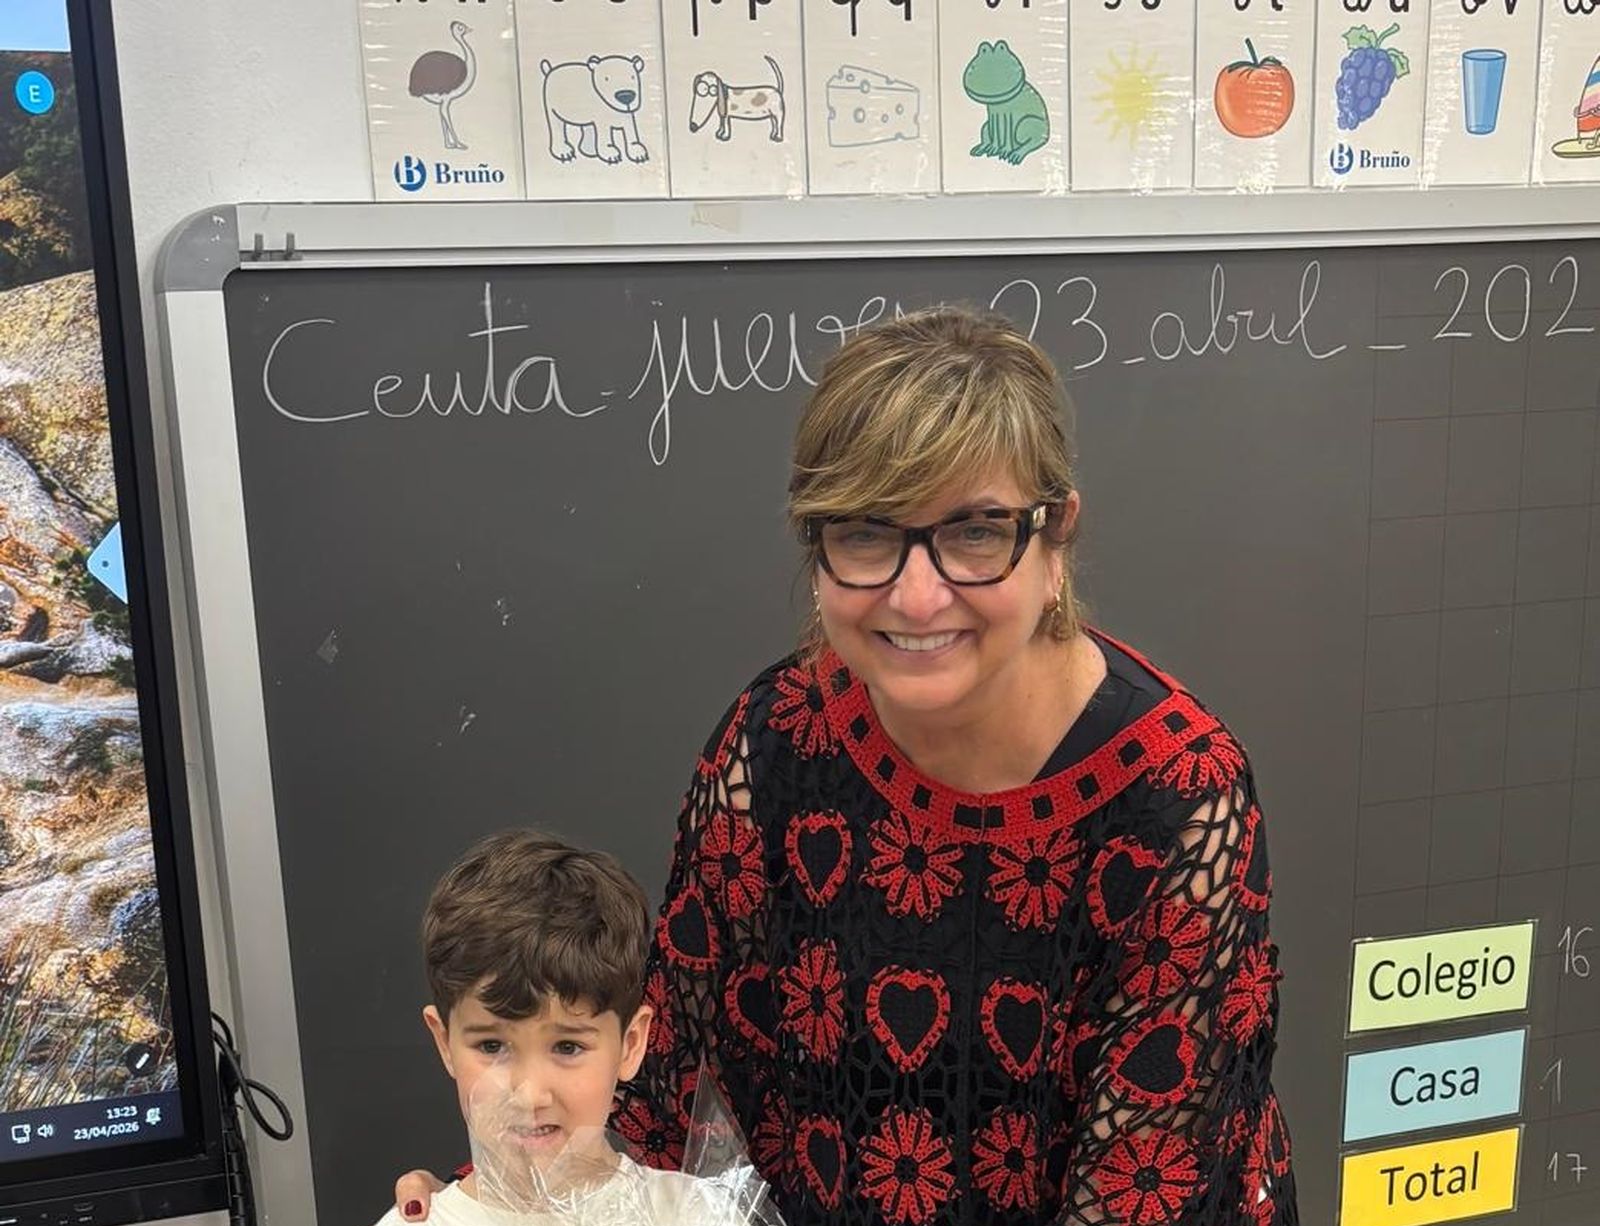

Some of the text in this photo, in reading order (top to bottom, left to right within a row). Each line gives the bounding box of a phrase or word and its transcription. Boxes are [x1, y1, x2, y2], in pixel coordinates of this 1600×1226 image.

[29, 84, 42, 103] E
[435, 162, 504, 184] Bruño
[1359, 149, 1411, 168] Bruño
[628, 296, 906, 465] jueve
[989, 276, 1108, 370] 23
[1150, 260, 1348, 360] abril
[1432, 256, 1596, 342] 202
[1557, 925, 1594, 978] 16
[1367, 946, 1516, 1001] Colegio
[1389, 1065, 1481, 1107] Casa
[106, 1105, 139, 1120] 13:23
[73, 1121, 140, 1141] 23/04/2026
[1380, 1150, 1481, 1206] Total
[1546, 1151, 1589, 1184] 17
